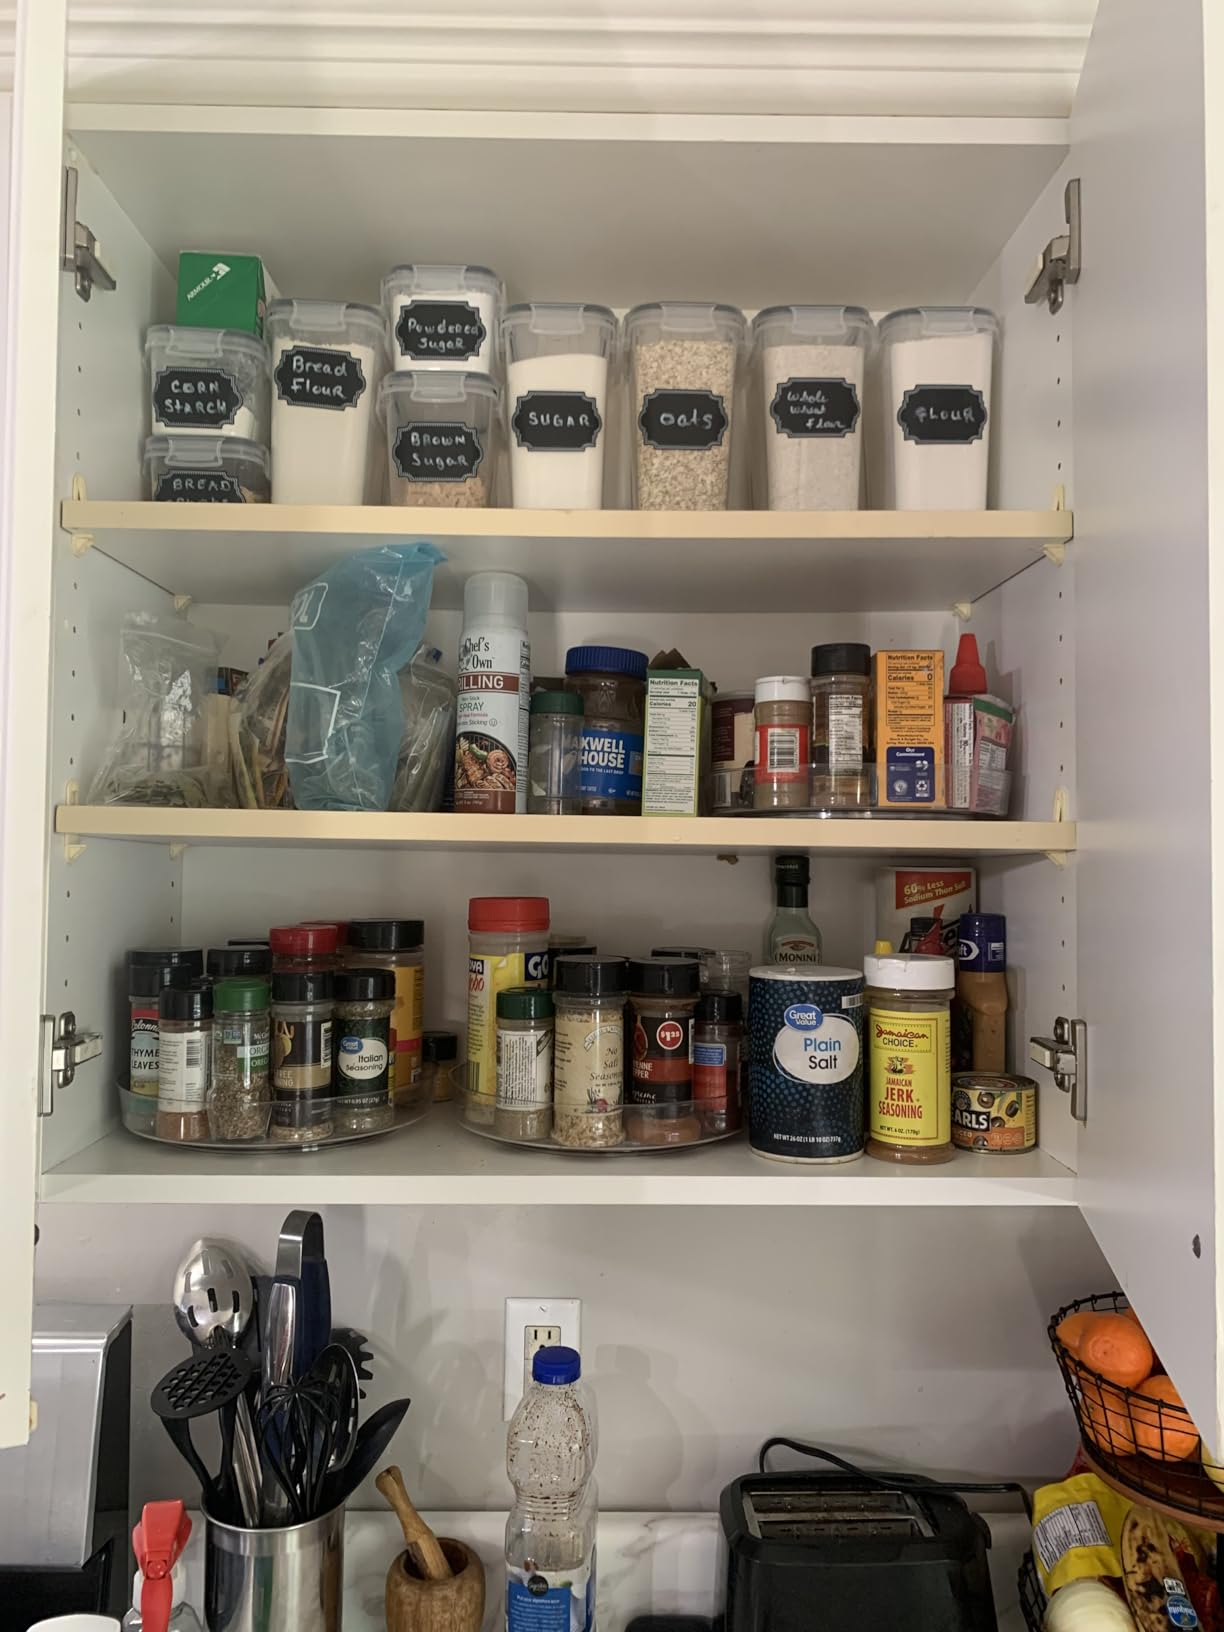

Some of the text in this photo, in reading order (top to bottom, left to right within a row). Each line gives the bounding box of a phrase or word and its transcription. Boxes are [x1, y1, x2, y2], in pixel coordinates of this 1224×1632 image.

[292, 355, 348, 376] Bread
[170, 380, 220, 394] CORN
[528, 411, 590, 427] SUGAR
[172, 479, 231, 491] BREAD
[472, 654, 493, 669] Own
[927, 673, 933, 681] 0
[459, 702, 484, 713] SPRAY
[579, 751, 625, 768] HOUSE
[927, 881, 944, 889] Less
[904, 892, 933, 904] Sodium
[935, 886, 953, 896] Than
[780, 952, 816, 962] MONINI
[789, 1010, 816, 1020] Great
[804, 1037, 841, 1052] Plain
[882, 1037, 914, 1048] CHOICE
[359, 1054, 384, 1063] Italian
[809, 1055, 837, 1070] Salt
[345, 1063, 383, 1072] Seasoning
[886, 1077, 913, 1087] JAMAICAN
[885, 1087, 914, 1103] JERK
[879, 1101, 923, 1119] SEASONING
